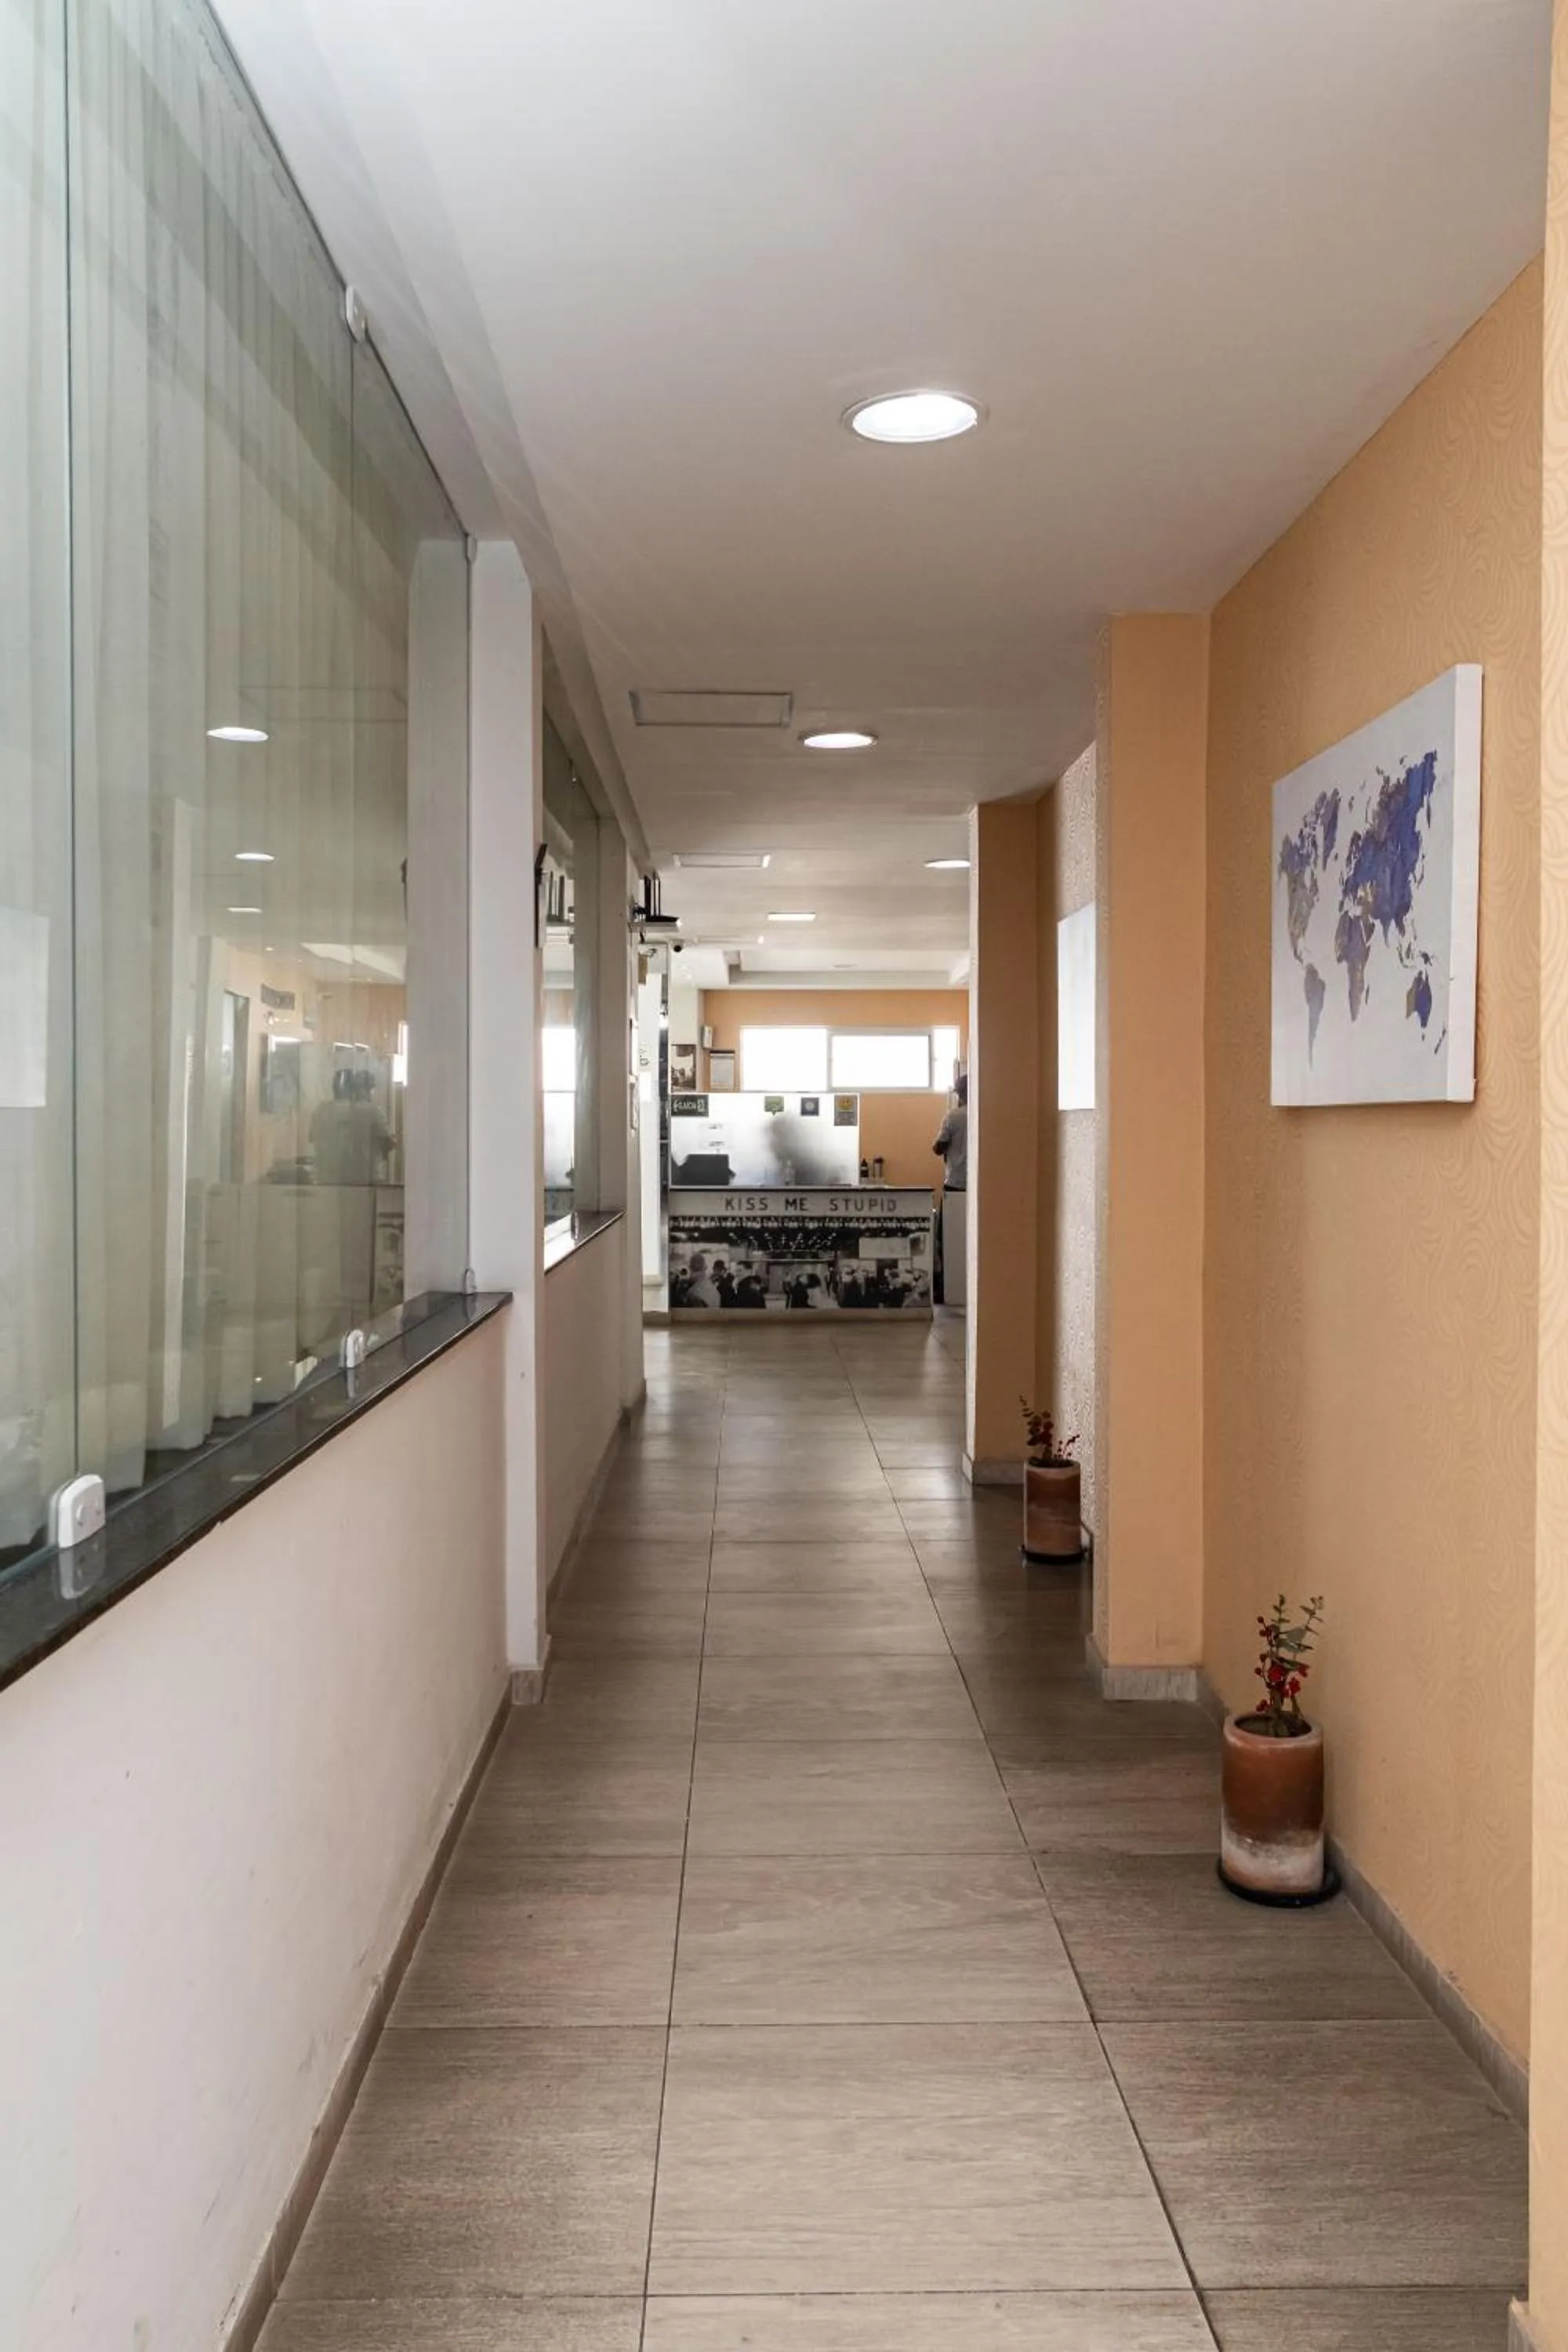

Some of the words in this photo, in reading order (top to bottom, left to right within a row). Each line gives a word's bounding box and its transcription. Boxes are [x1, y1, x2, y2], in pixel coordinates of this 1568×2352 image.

[725, 1197, 768, 1211] KISS
[785, 1197, 809, 1211] ME
[829, 1197, 897, 1212] STUPID
